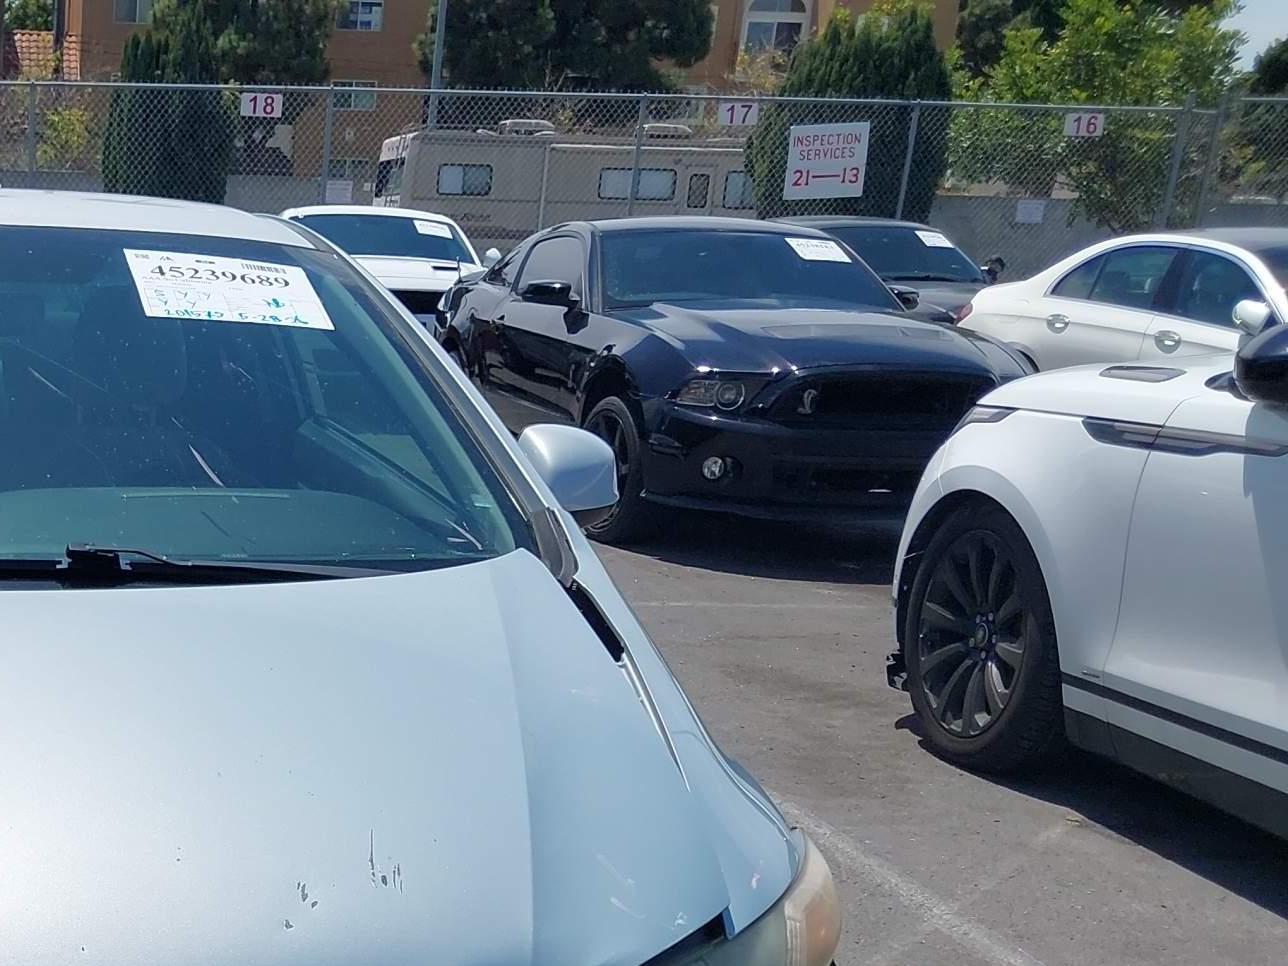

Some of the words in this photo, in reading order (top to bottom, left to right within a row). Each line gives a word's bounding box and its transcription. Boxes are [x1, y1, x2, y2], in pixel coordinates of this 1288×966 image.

[249, 95, 275, 115] 18
[727, 104, 753, 124] 17
[1073, 115, 1098, 135] 16
[793, 132, 862, 147] INSPECTION
[799, 146, 856, 161] SERVICES
[150, 265, 290, 288] 45239689
